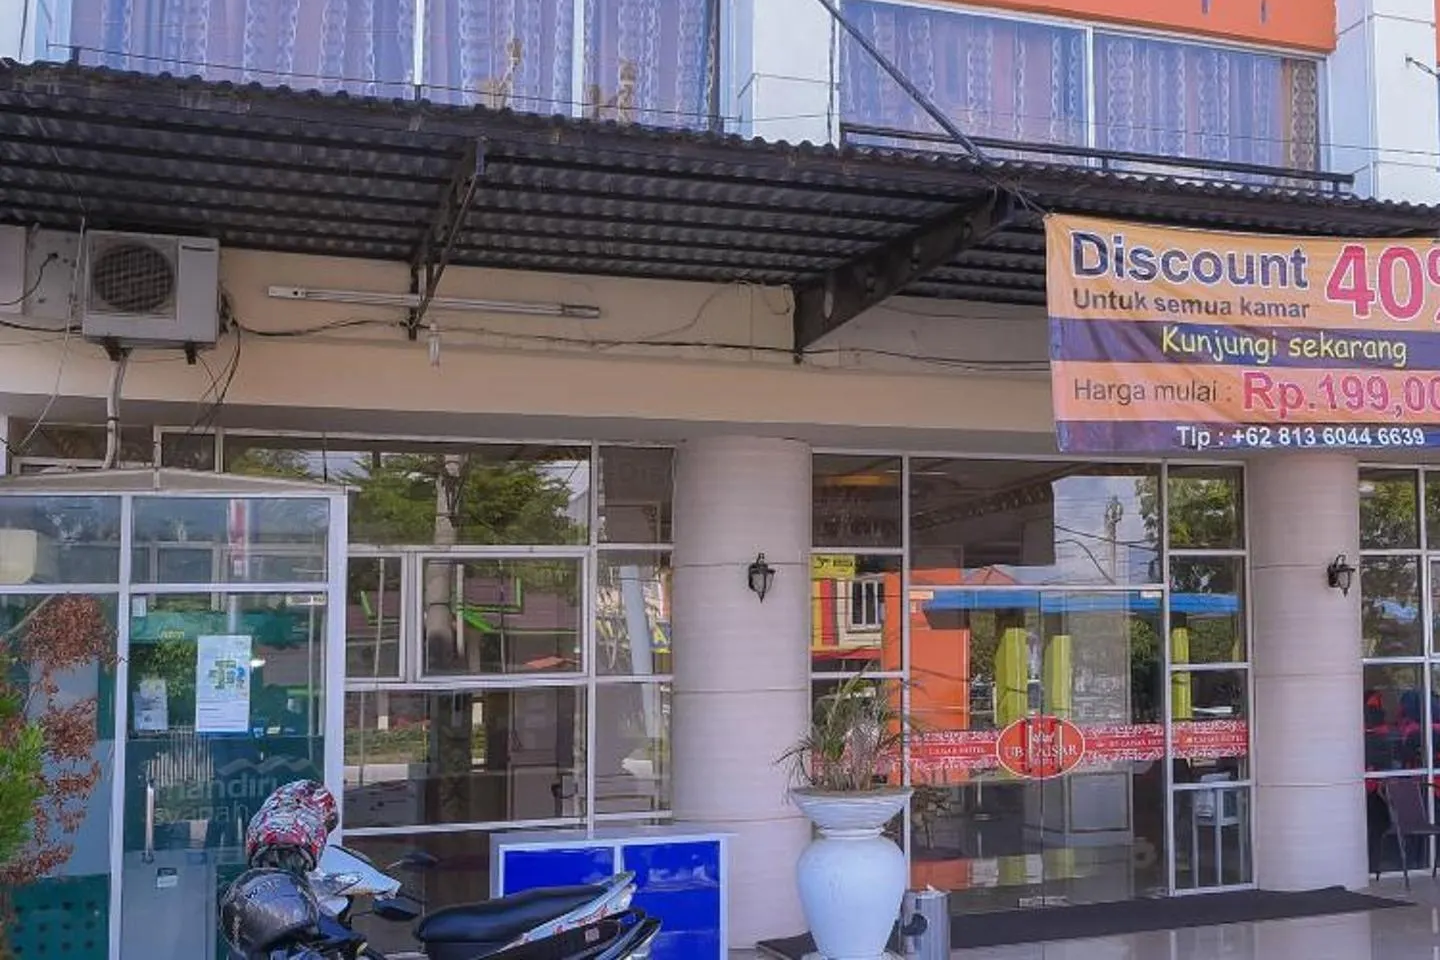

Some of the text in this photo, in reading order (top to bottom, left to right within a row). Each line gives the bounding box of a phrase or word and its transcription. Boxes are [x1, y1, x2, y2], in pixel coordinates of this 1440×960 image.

[1071, 230, 1309, 289] Discount
[1073, 287, 1310, 318] Untuk semua kamar
[1162, 325, 1407, 368] Kunjungi sekarang
[1074, 378, 1146, 406] Harga
[1154, 380, 1217, 403] mulai
[1176, 425, 1211, 451] Tlp
[1232, 426, 1273, 446] +62
[1278, 427, 1316, 446] 813
[1322, 427, 1372, 446] 6044
[1377, 427, 1425, 446] 6639
